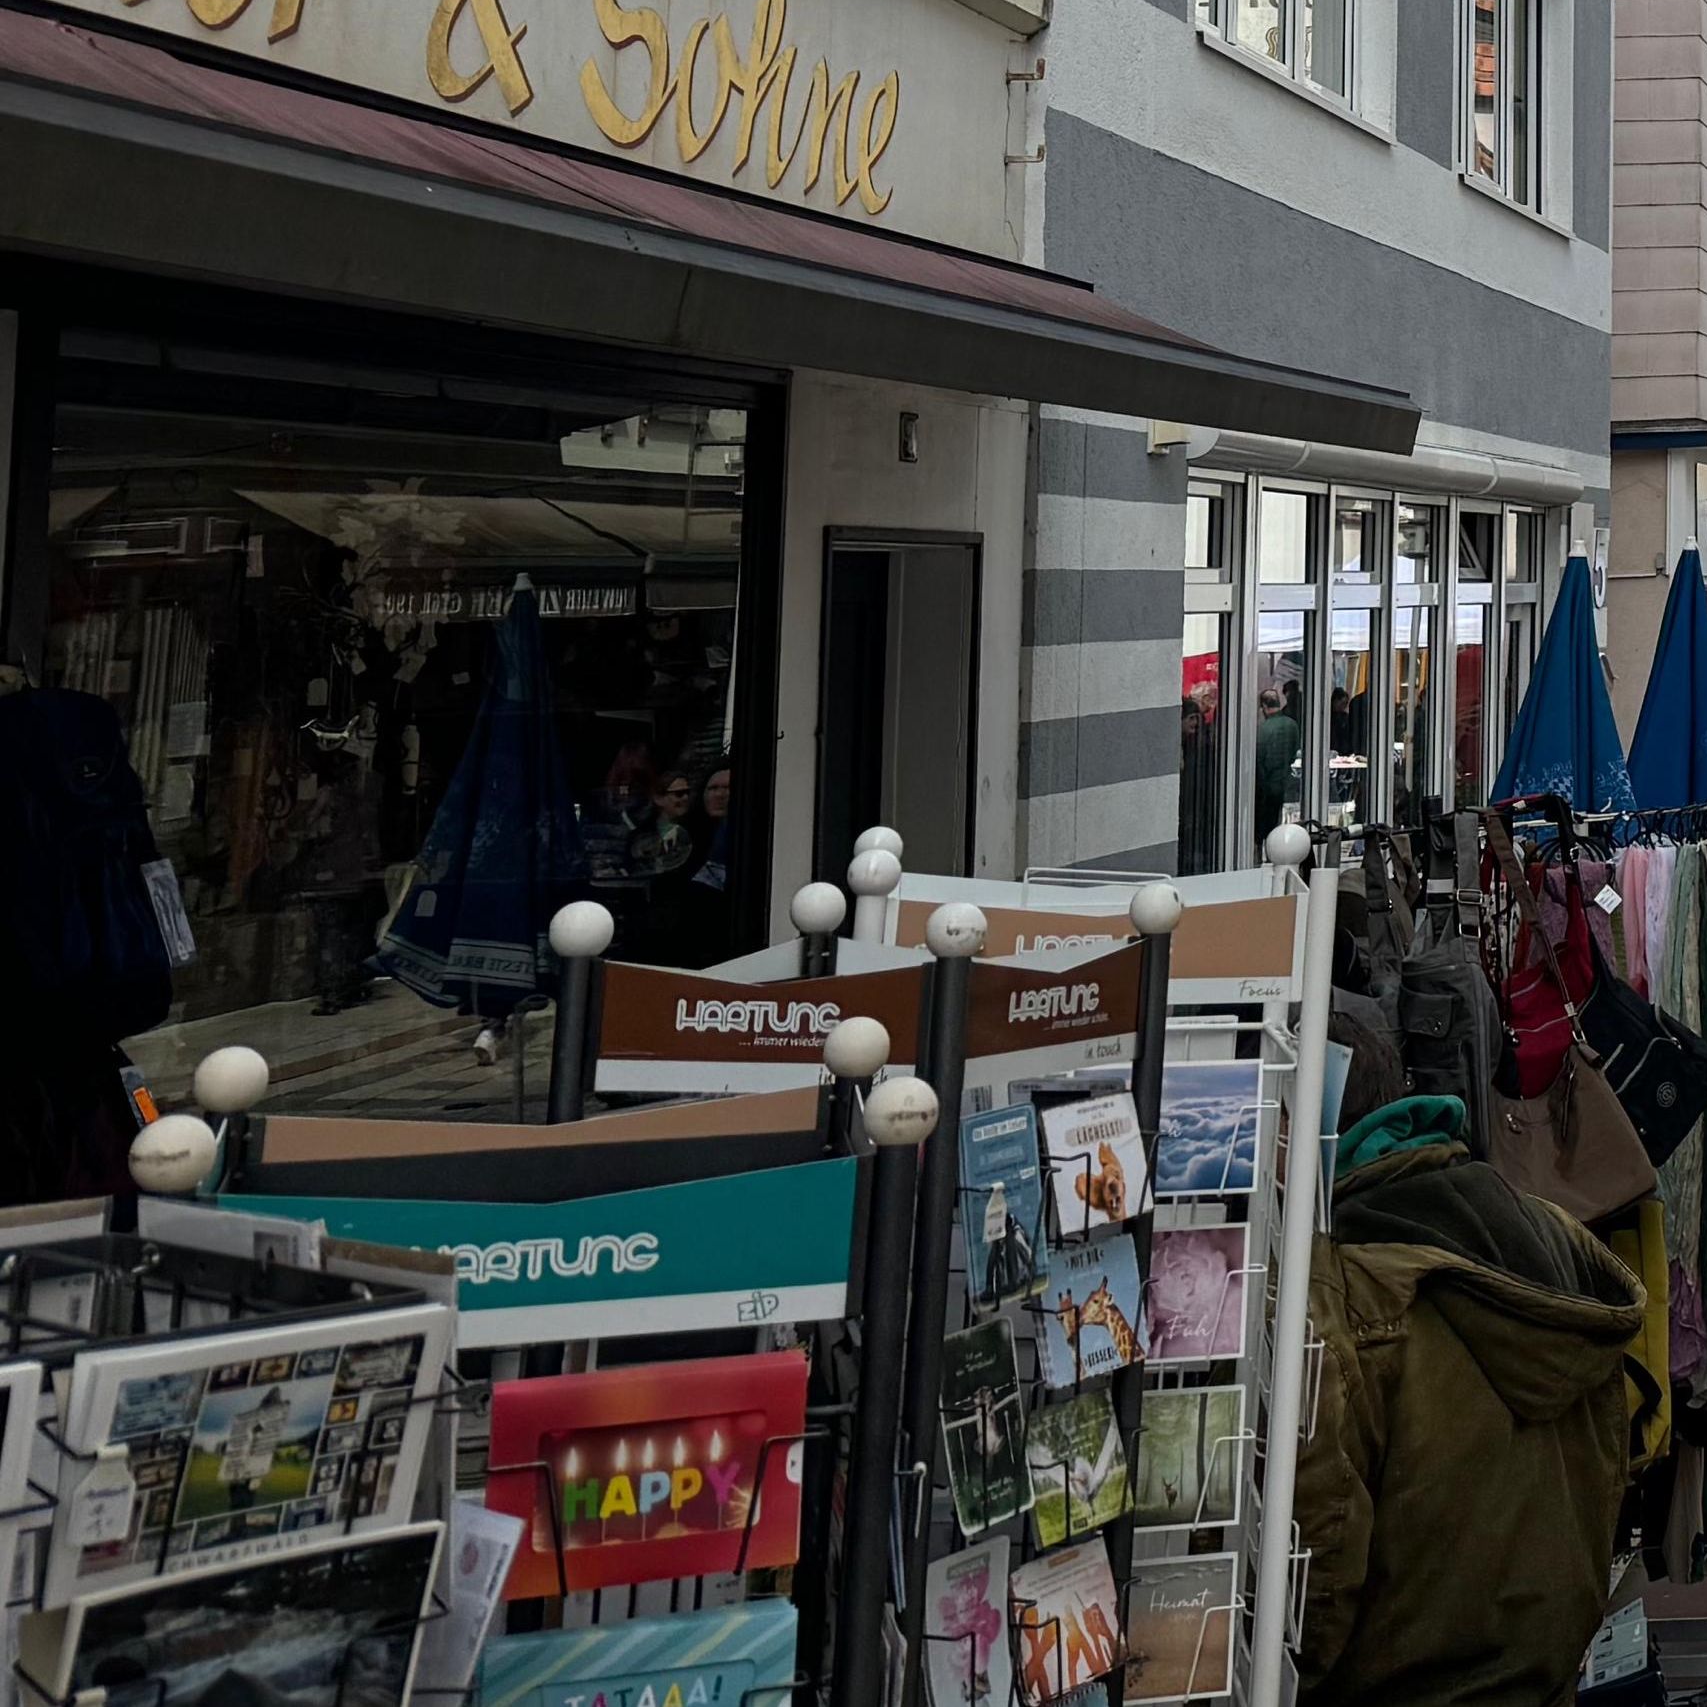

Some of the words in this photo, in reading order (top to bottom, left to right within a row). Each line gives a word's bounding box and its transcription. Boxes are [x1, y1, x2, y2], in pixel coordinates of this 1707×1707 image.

[676, 998, 842, 1035] HARTUNG
[1008, 982, 1099, 1023] HARTUNG
[436, 1232, 660, 1285] ARTUNG
[563, 1462, 741, 1524] HAPPY
[1149, 1590, 1210, 1613] Heimat
